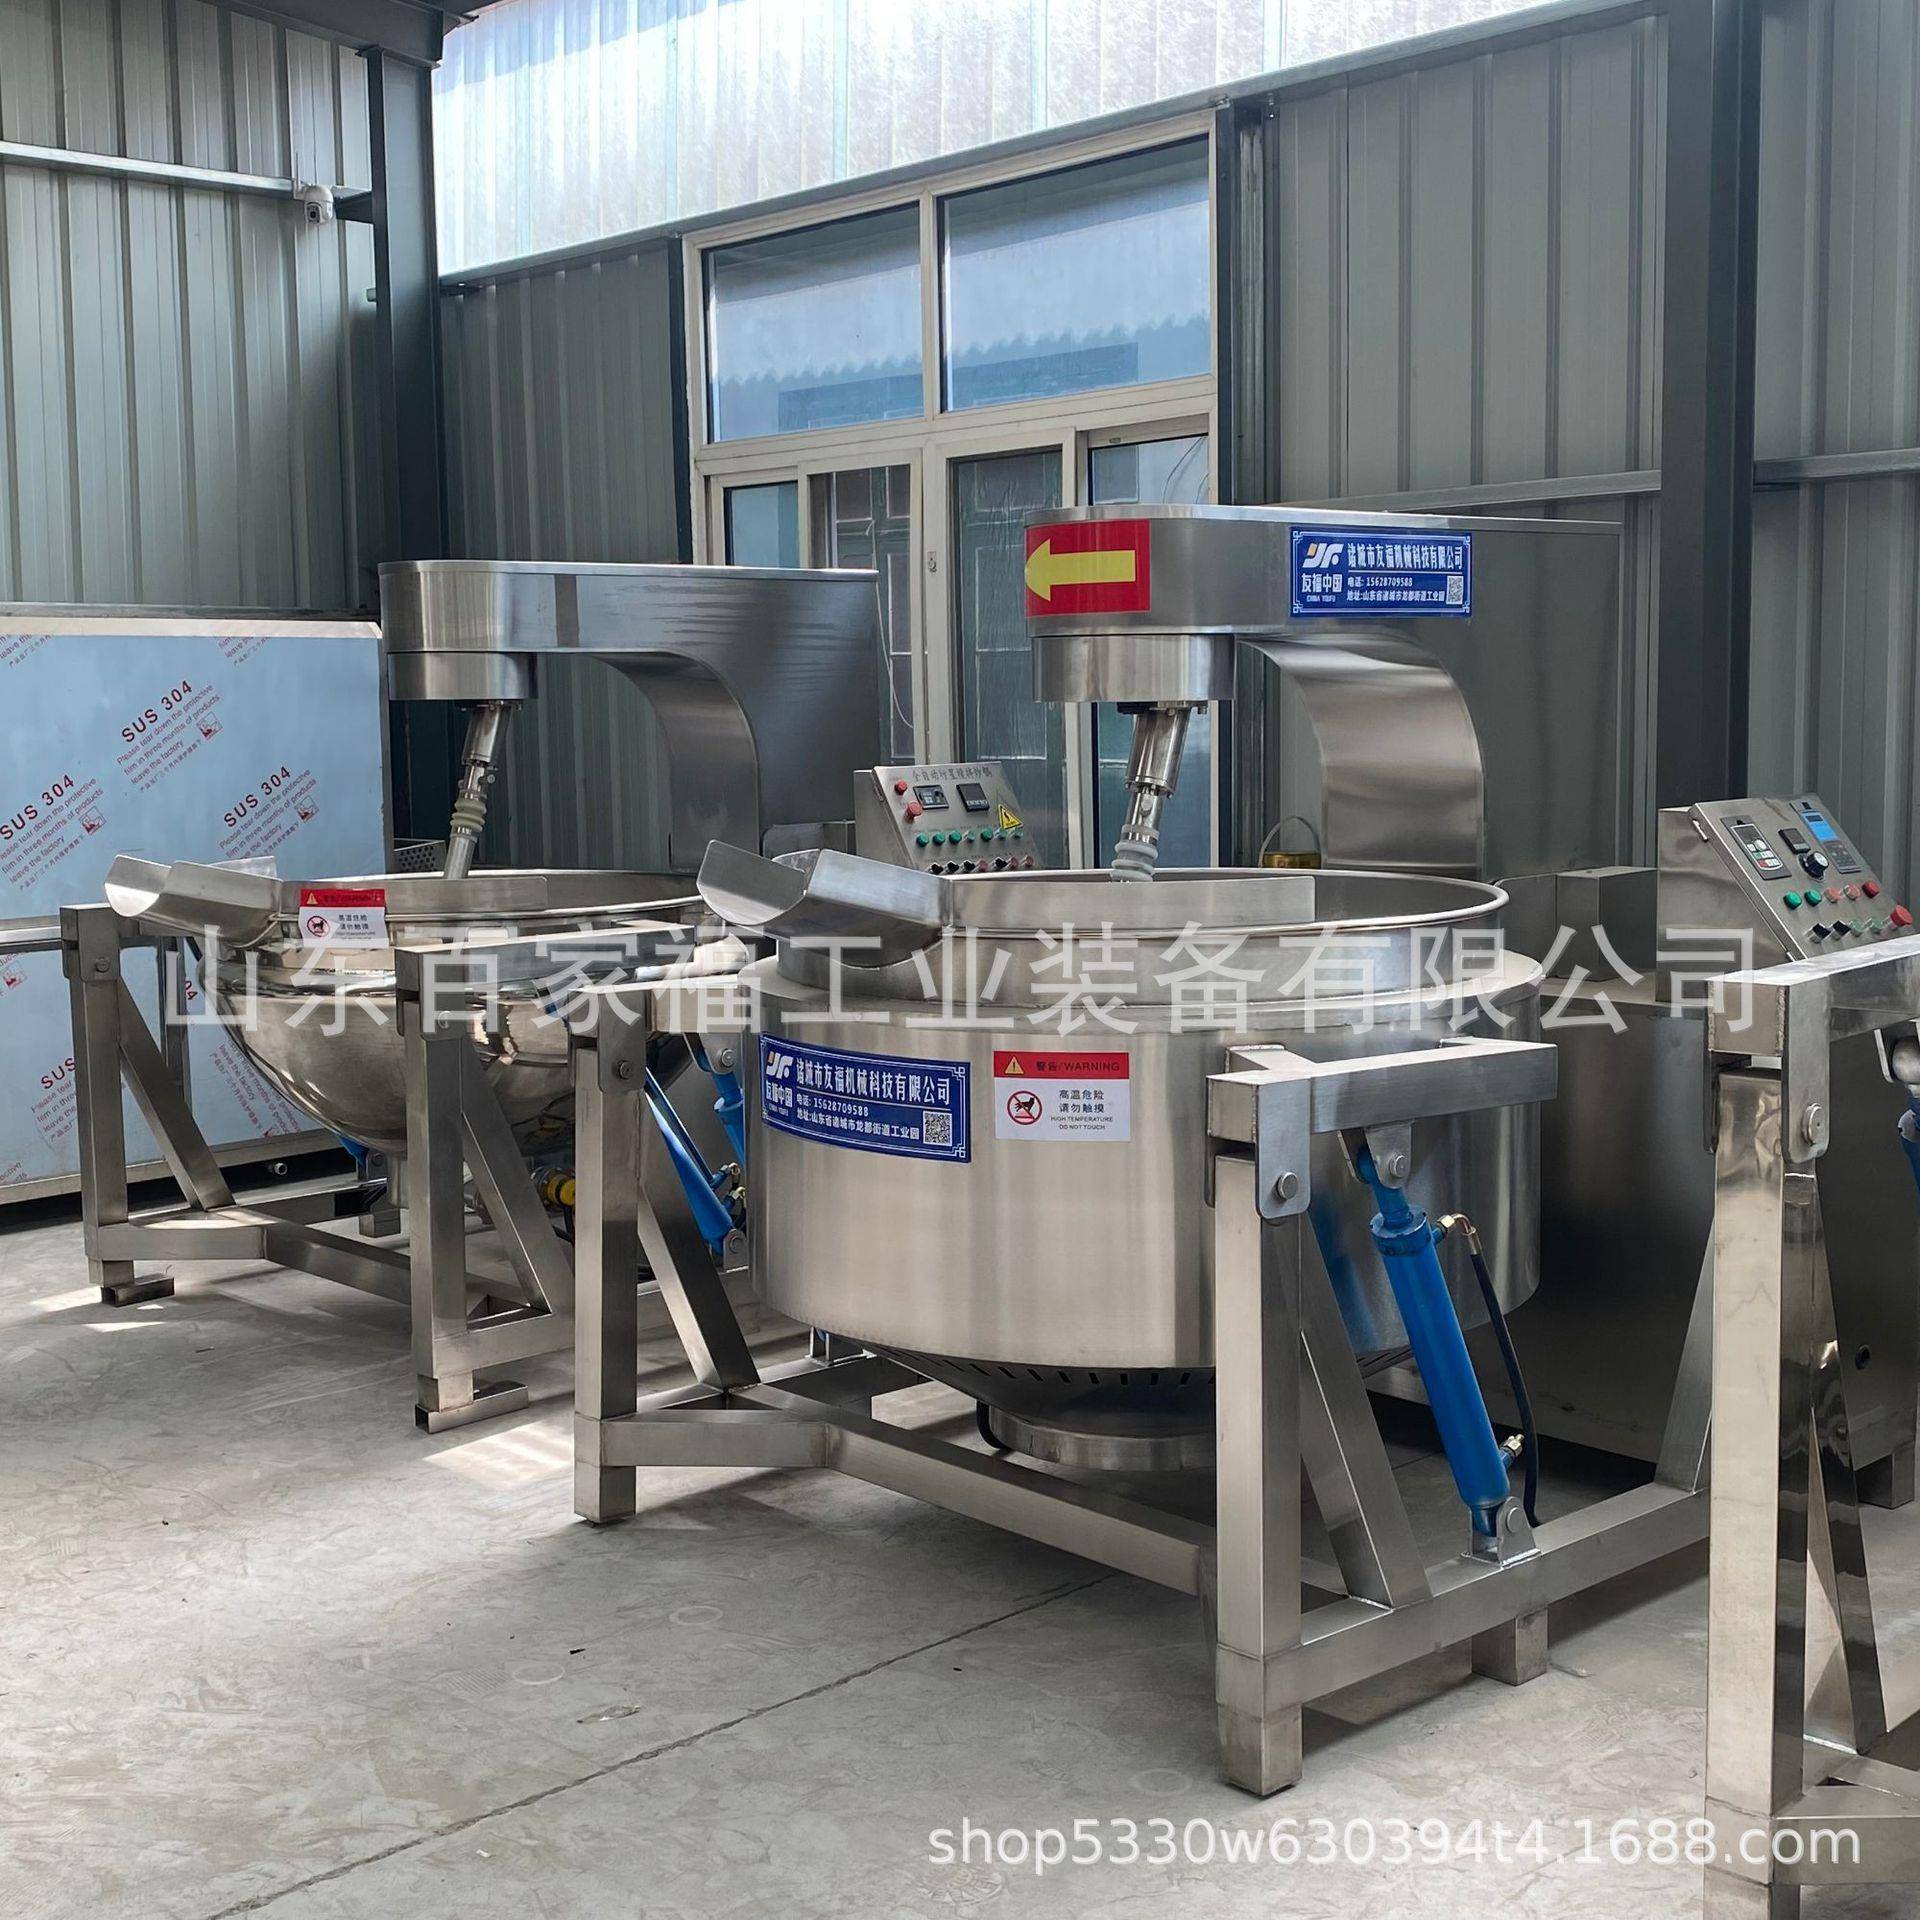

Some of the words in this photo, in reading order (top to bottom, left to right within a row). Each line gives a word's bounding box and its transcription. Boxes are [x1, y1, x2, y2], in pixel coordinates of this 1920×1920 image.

[1347, 542, 1463, 570] 诸城市友福机械科技有限公司
[1301, 573, 1343, 593] 友福中国
[1366, 577, 1413, 587] 15628709588
[121, 708, 158, 743] SUS
[161, 680, 192, 711] 304
[0, 804, 38, 840] SUS
[41, 774, 74, 806] 304
[223, 794, 258, 827] SUS
[260, 766, 291, 796] 304
[41, 1057, 77, 1090] SUS
[796, 1057, 950, 1105] 诸城市友福机械科技有限公司
[765, 1080, 793, 1108] 友福中国
[813, 1097, 869, 1117] 15628709588
[1059, 1089, 1104, 1100] 高温危险
[1059, 1103, 1104, 1113] 请勿触摸
